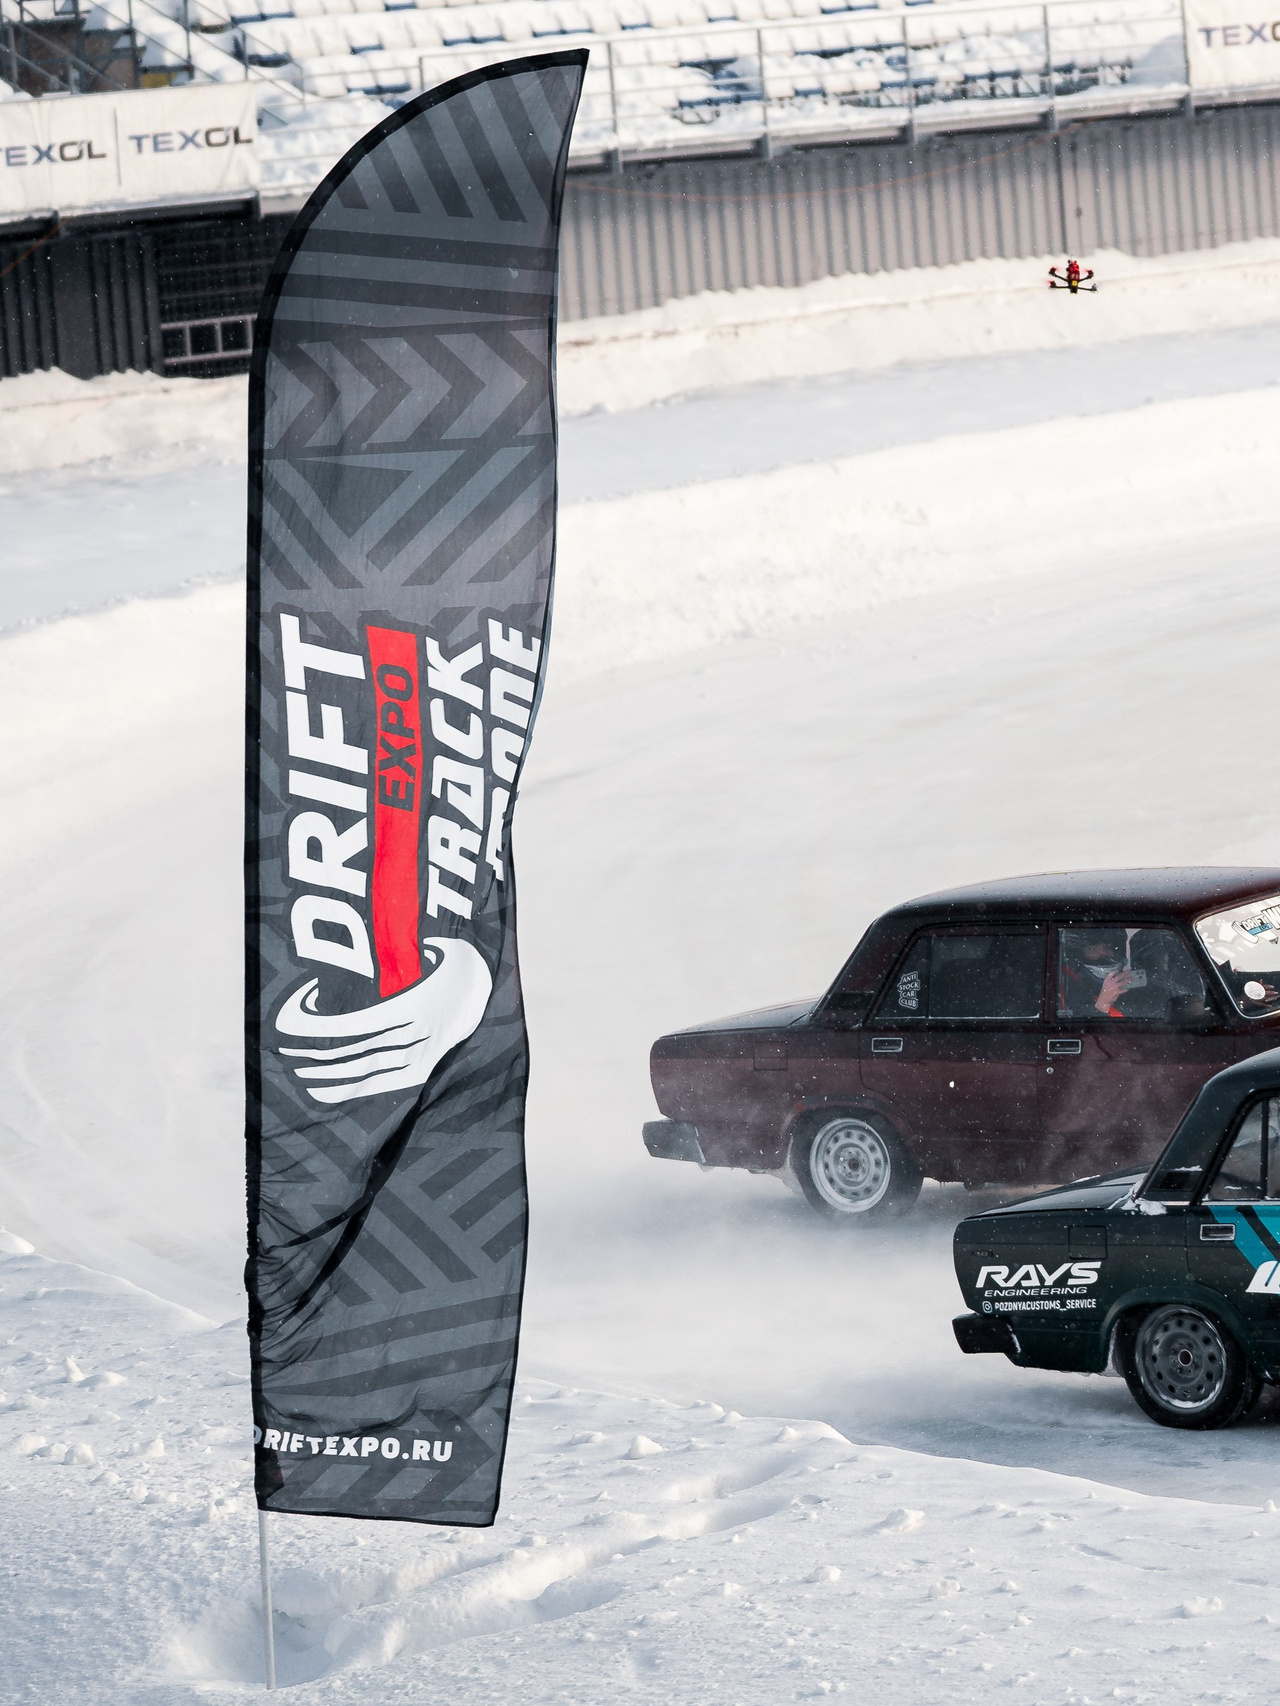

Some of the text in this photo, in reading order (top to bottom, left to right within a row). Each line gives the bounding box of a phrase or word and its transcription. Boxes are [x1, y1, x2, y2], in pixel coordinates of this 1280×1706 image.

[128, 125, 254, 155] TEXOL
[0, 139, 107, 167] EXOL
[376, 663, 418, 813] EXPO
[425, 635, 484, 920] TRACK
[279, 613, 374, 979] DRIFT
[900, 982, 919, 991] STOCK
[902, 973, 917, 983] ANTI
[901, 999, 917, 1007] CLUB
[902, 990, 915, 998] CAR
[975, 1262, 1102, 1288] RAYS
[984, 1286, 1088, 1297] ENGINEERING
[995, 1299, 1097, 1311] POZDNYACUSTOMS_SERVICE
